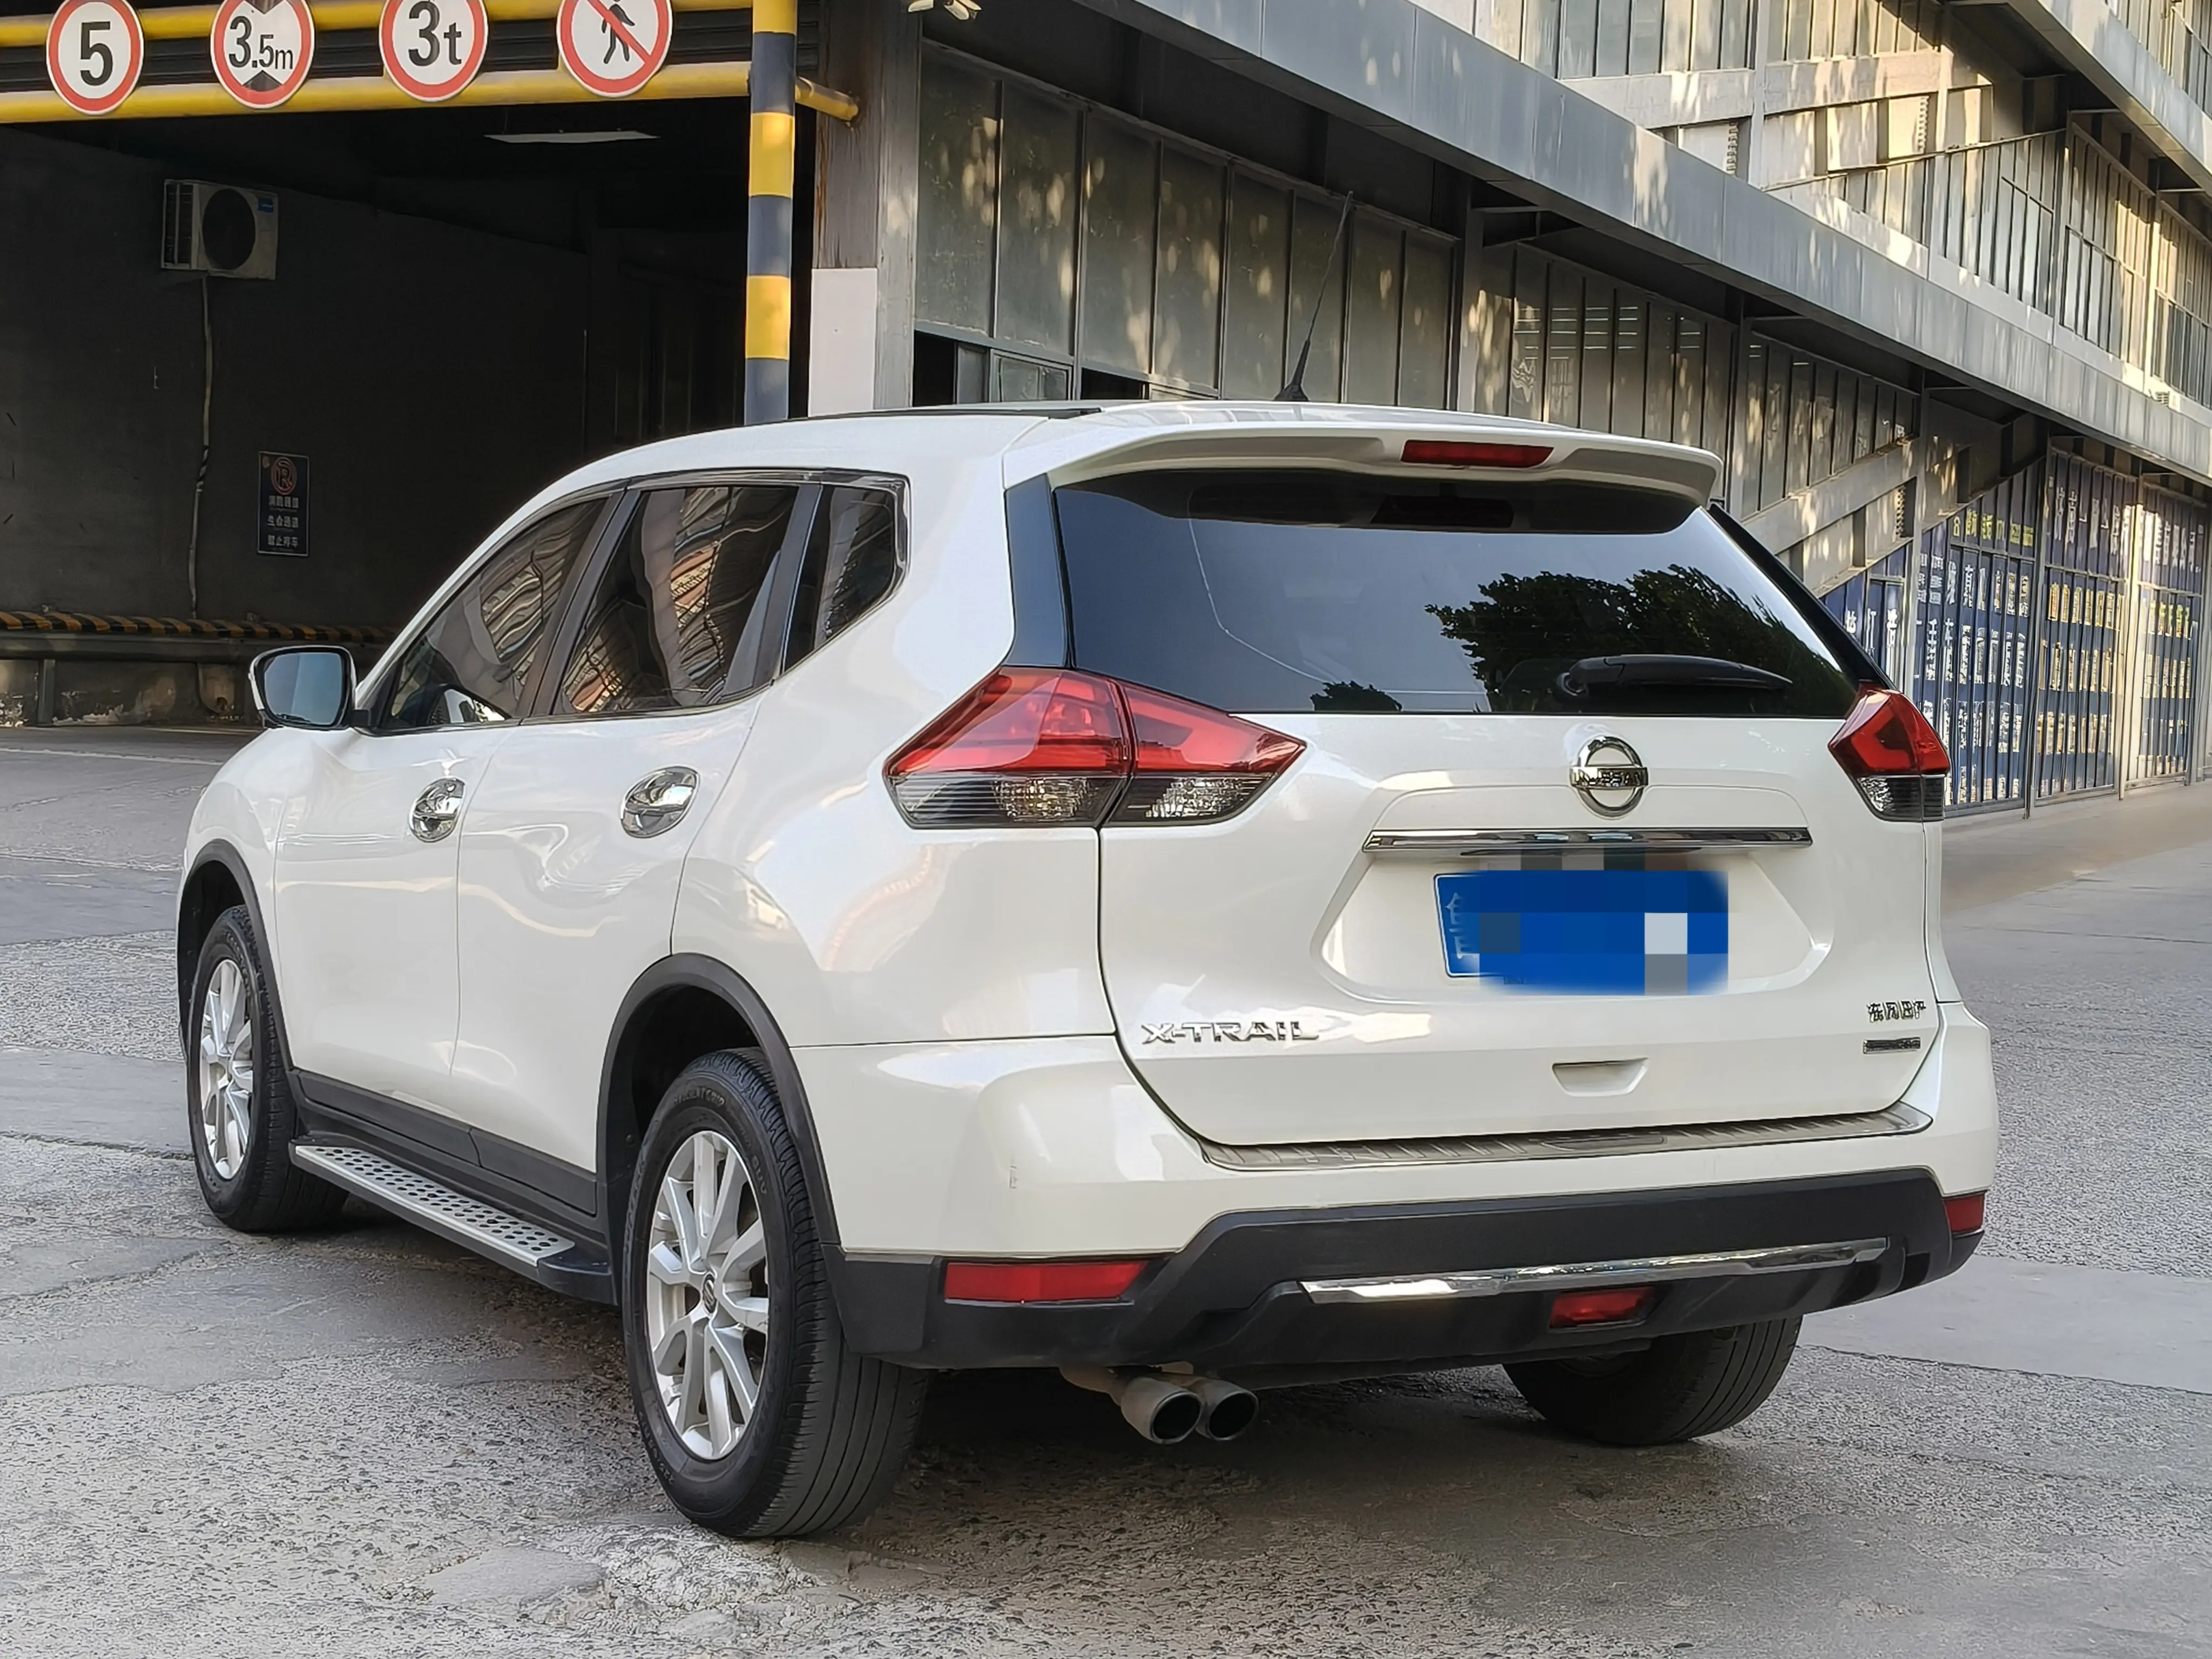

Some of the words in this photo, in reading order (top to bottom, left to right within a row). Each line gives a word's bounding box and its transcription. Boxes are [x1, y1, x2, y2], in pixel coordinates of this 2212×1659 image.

[80, 21, 113, 86] 5
[228, 15, 293, 70] 3.5m
[408, 1, 462, 67] 3t
[1141, 1022, 1319, 1045] X-TRAIL
